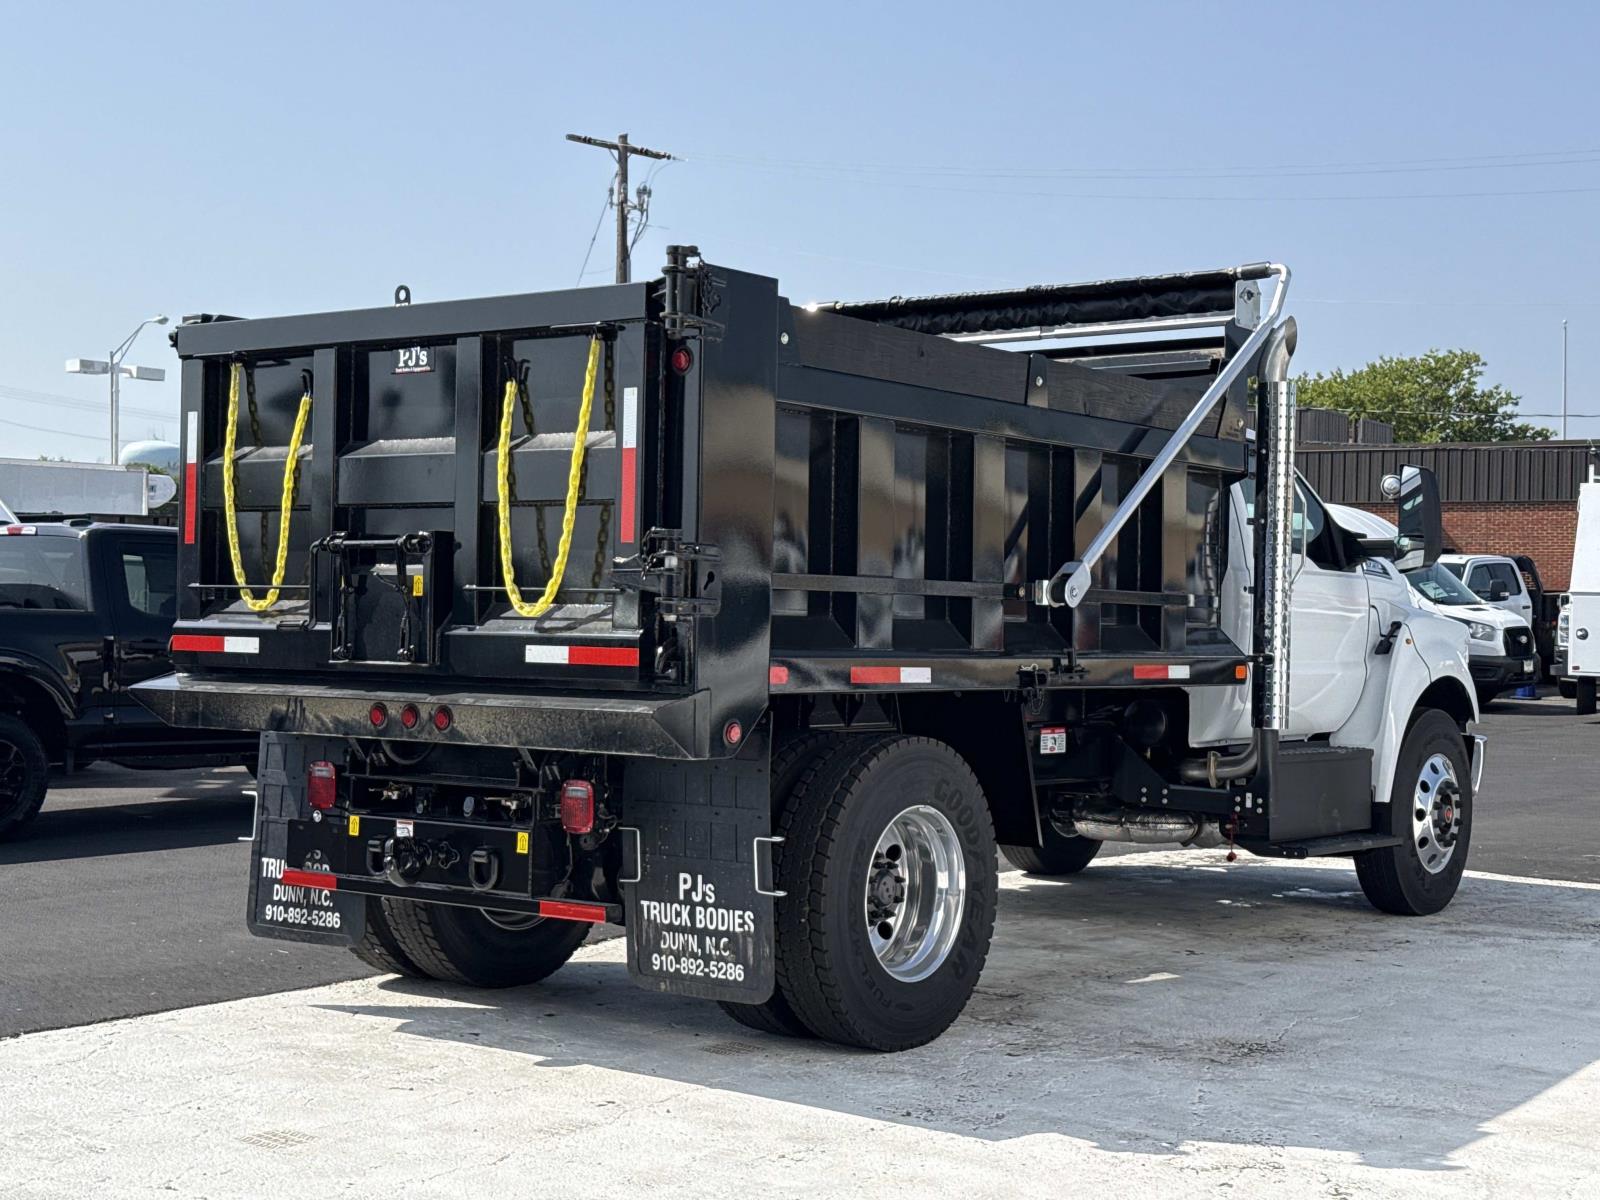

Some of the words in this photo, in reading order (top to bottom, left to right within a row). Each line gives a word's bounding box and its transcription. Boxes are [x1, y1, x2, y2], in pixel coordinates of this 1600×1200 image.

[398, 346, 428, 367] PJ's
[261, 857, 287, 879] TRU
[273, 884, 307, 907] DUNN,
[310, 888, 334, 908] N.C.
[678, 872, 716, 904] PJ's
[265, 904, 341, 928] 910-892-5286
[640, 900, 692, 927] TRUCK
[695, 906, 755, 934] BODIES
[660, 931, 702, 957] DUNN,
[651, 953, 745, 982] 910-892-5286
